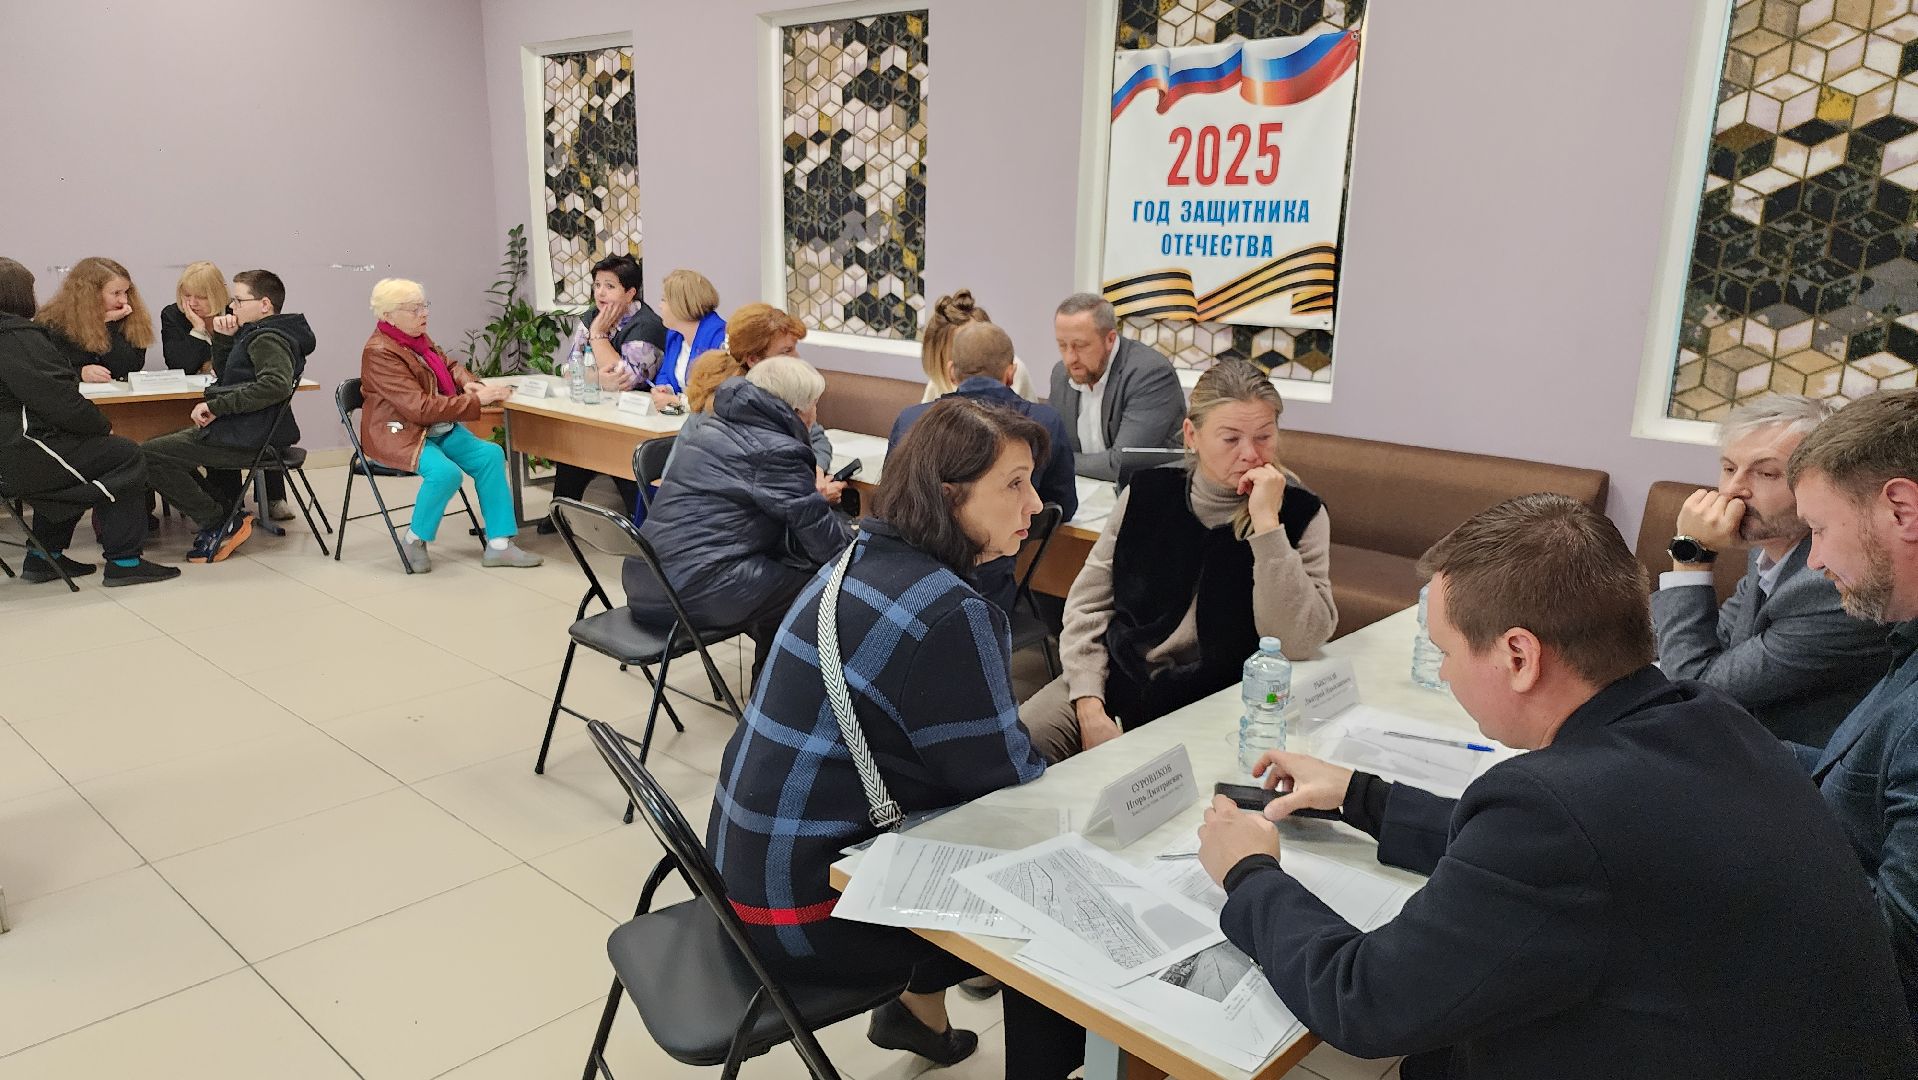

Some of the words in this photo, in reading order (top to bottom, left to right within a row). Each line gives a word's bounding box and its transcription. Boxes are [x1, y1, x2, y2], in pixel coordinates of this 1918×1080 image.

[1167, 122, 1283, 186] 2025
[1133, 200, 1170, 226] ГОД
[1181, 200, 1310, 226] ЗАЩИТНИКА
[1161, 233, 1273, 257] ОТЕЧЕСТВА
[1126, 795, 1147, 811] Игорь
